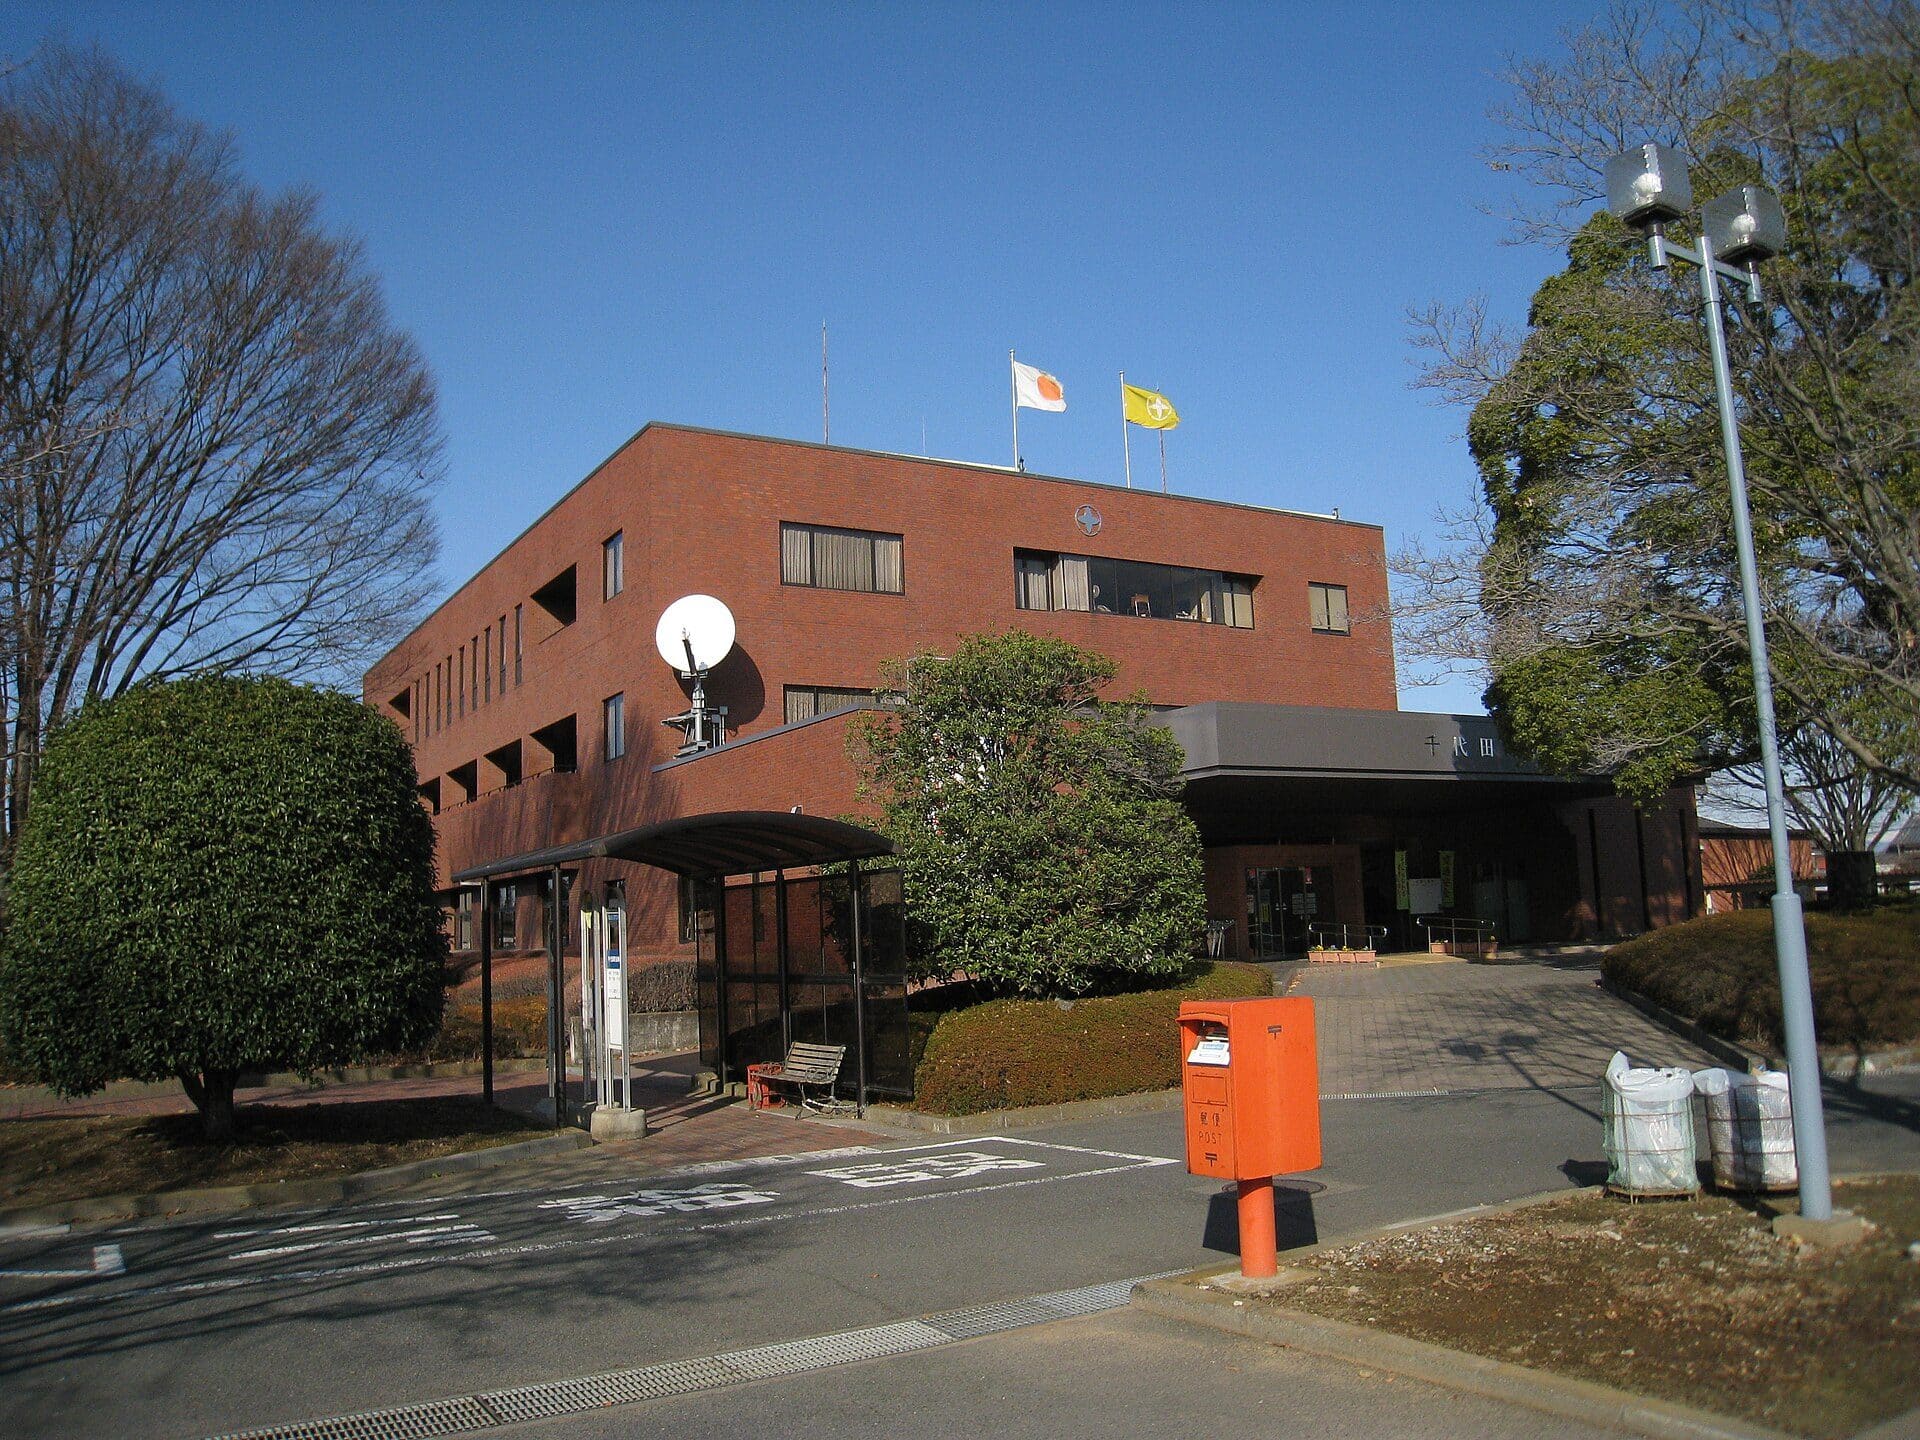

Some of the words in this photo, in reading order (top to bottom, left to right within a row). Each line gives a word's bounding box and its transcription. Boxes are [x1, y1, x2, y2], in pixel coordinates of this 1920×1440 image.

[1424, 734, 1494, 757] 千代田
[1198, 1130, 1222, 1144] POST
